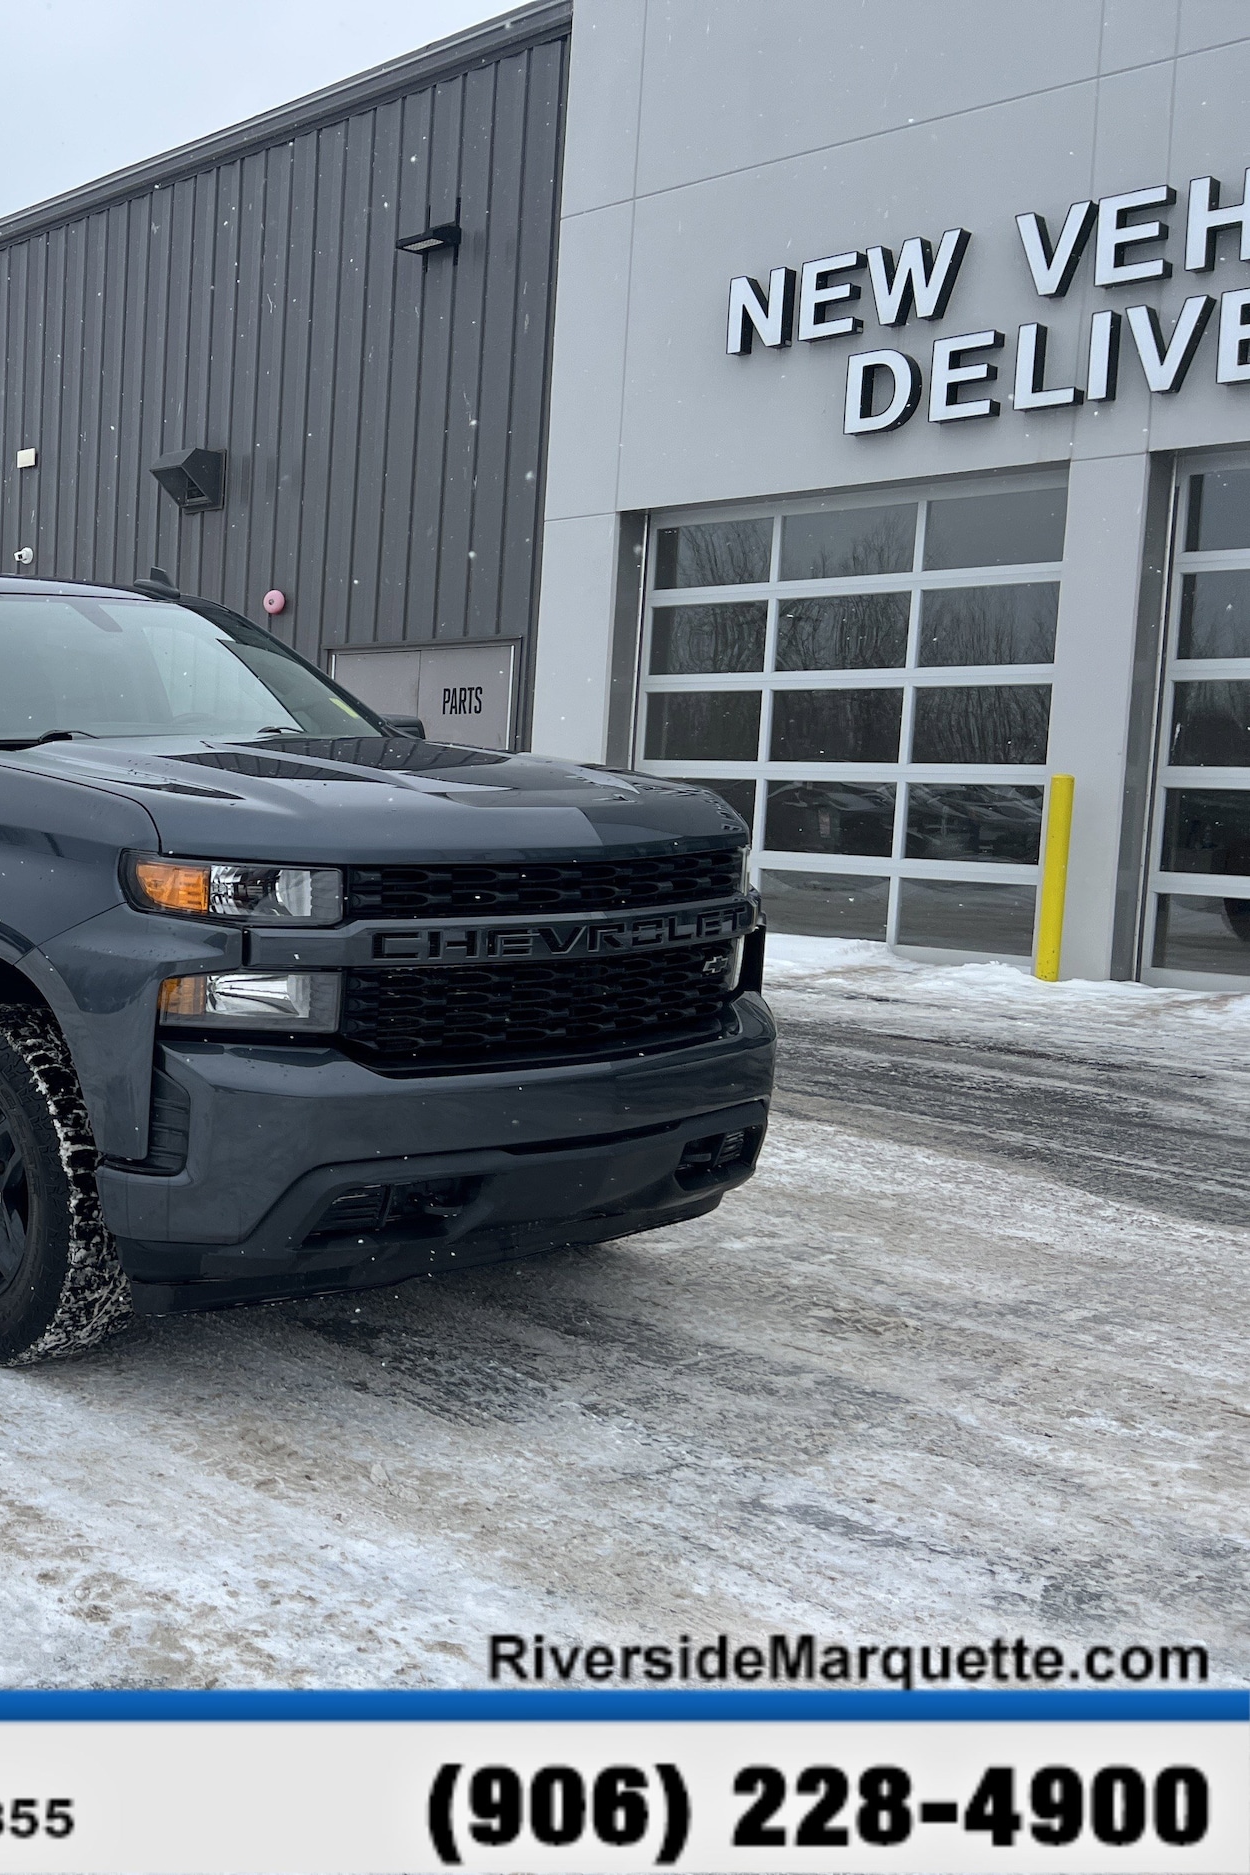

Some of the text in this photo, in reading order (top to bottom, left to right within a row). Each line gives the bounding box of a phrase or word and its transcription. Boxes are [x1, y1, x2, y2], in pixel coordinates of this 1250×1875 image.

[726, 167, 1250, 356] NEW VEH
[442, 686, 483, 715] PARTS
[370, 906, 747, 961] CHEVROLET
